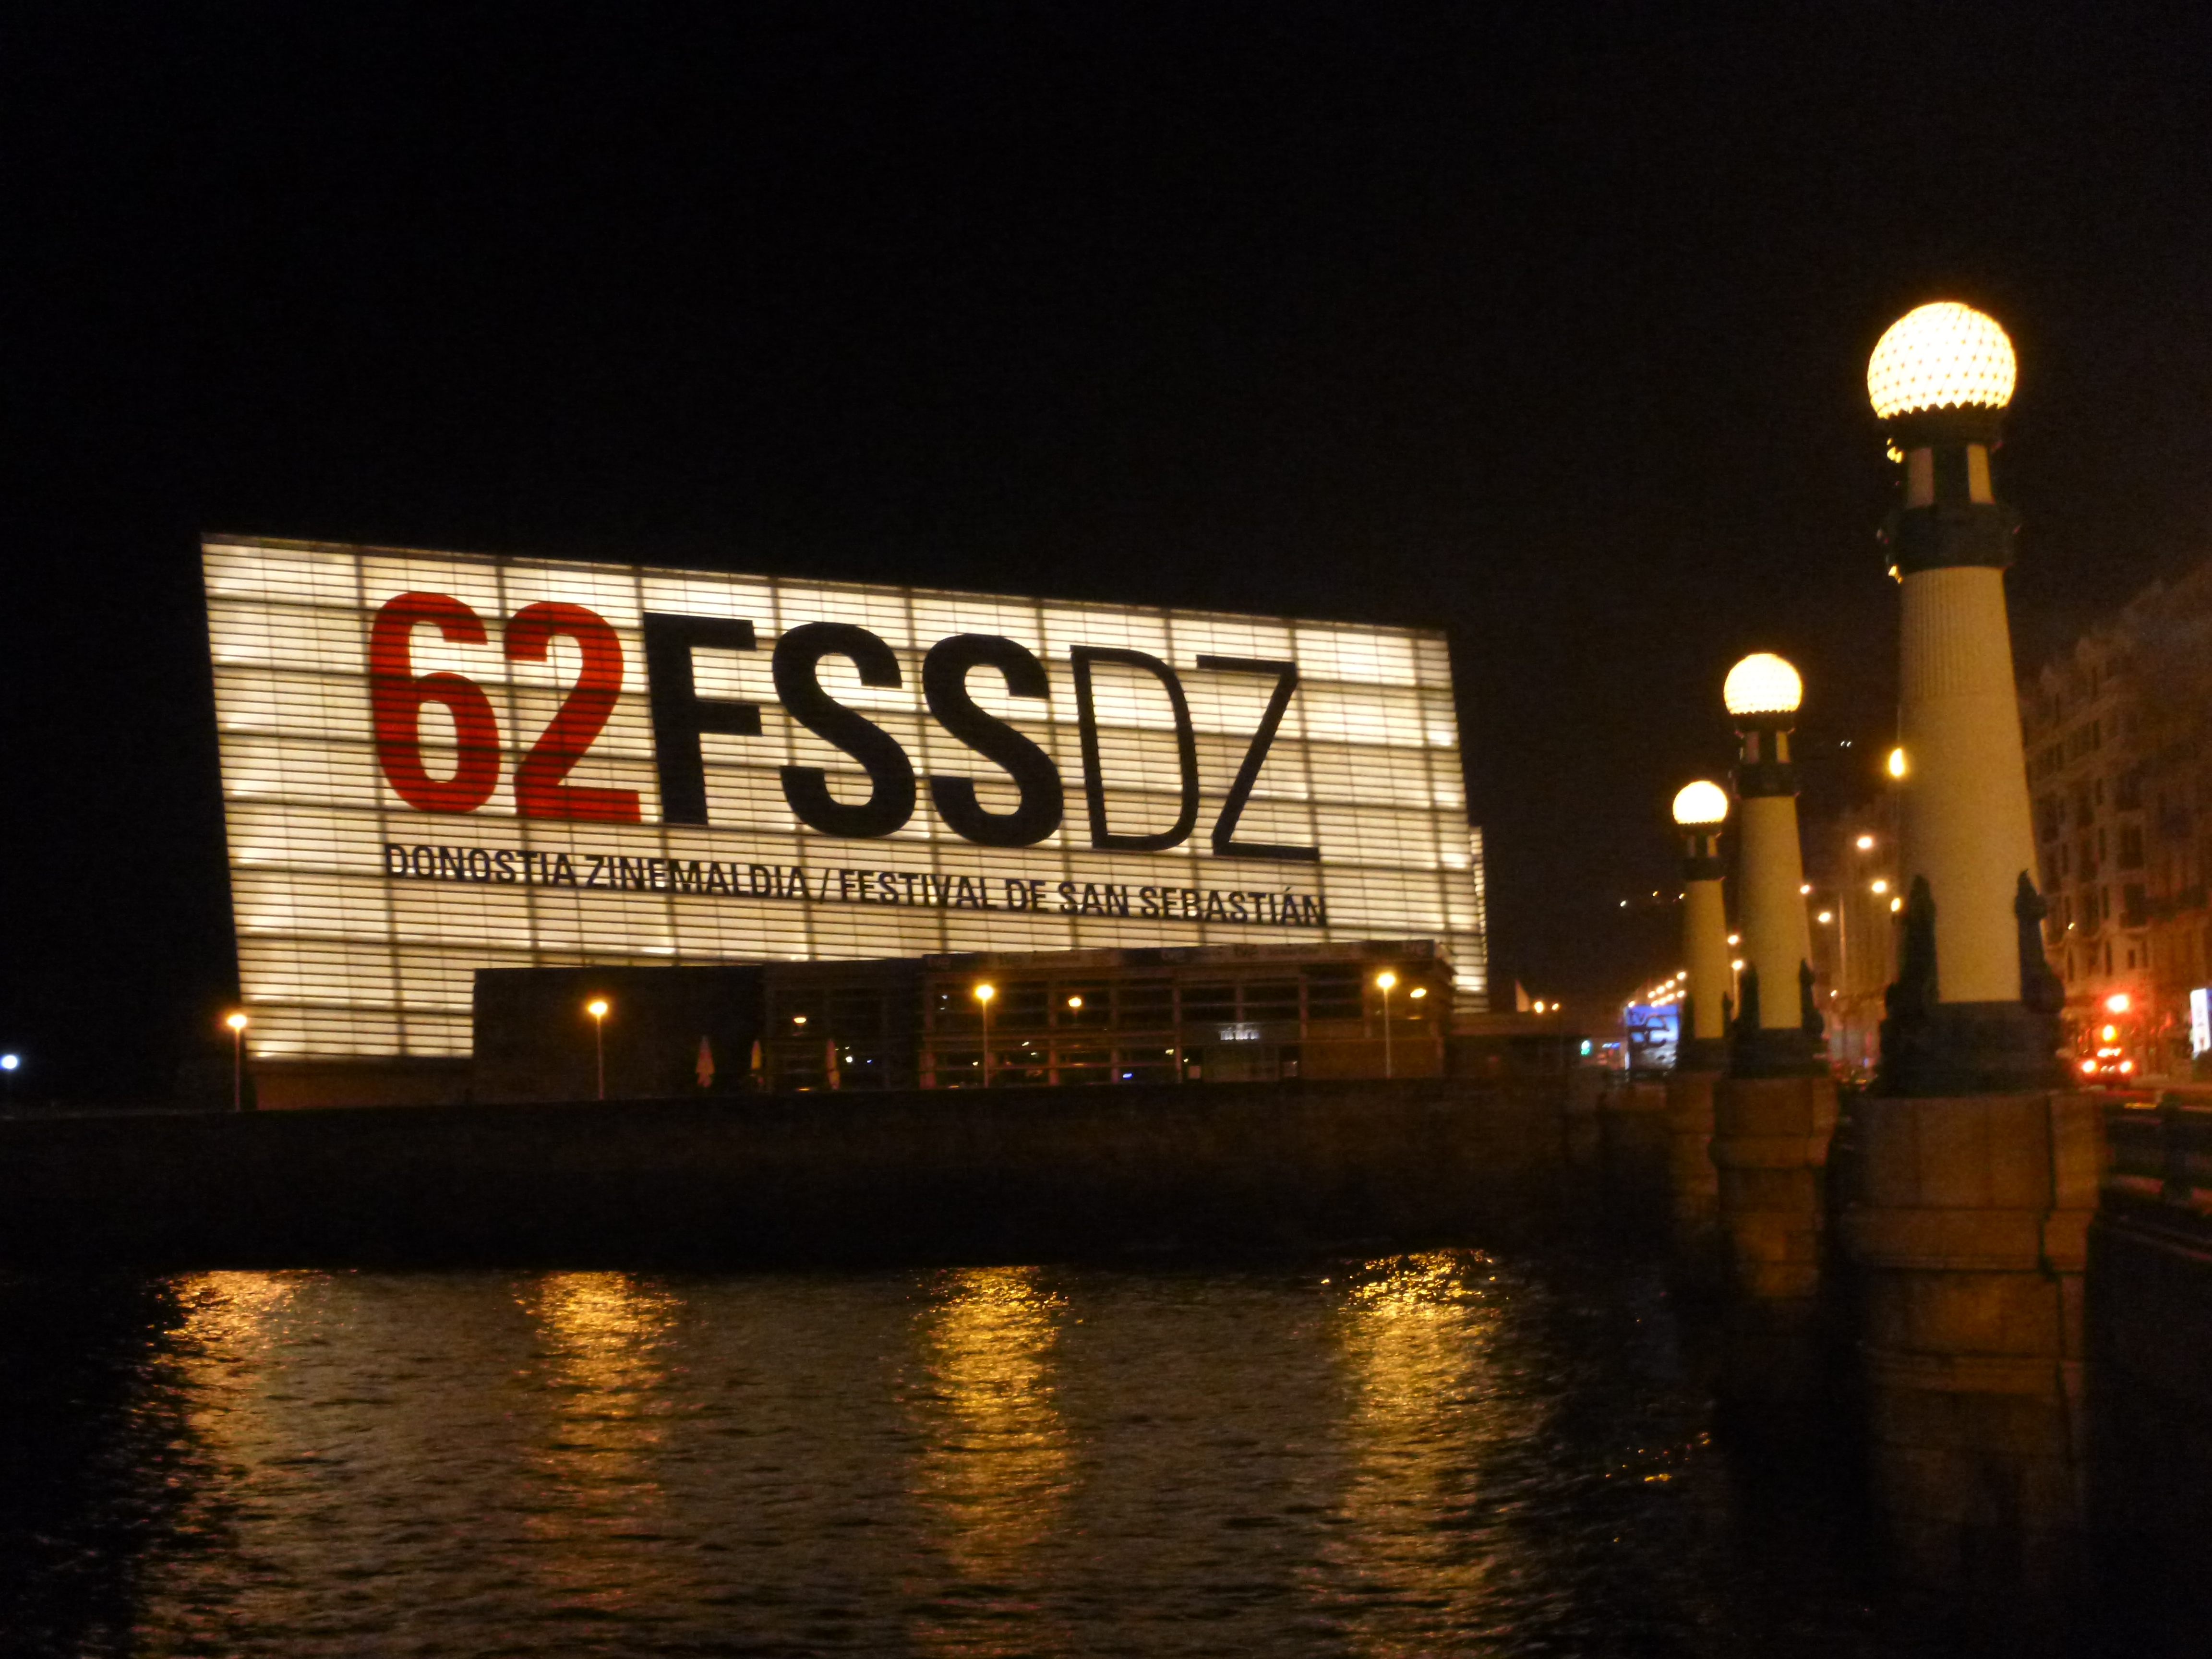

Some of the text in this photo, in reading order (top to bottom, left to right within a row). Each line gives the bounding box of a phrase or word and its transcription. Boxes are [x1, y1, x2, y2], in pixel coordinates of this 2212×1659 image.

[384, 843, 578, 888] DONOSTIA
[585, 854, 806, 901] ZINEMALDIA
[839, 868, 998, 911] FESTIVAL
[1006, 878, 1049, 914] DE
[1057, 880, 1131, 918] SAN
[1139, 886, 1329, 927] SEBASTIÁN
